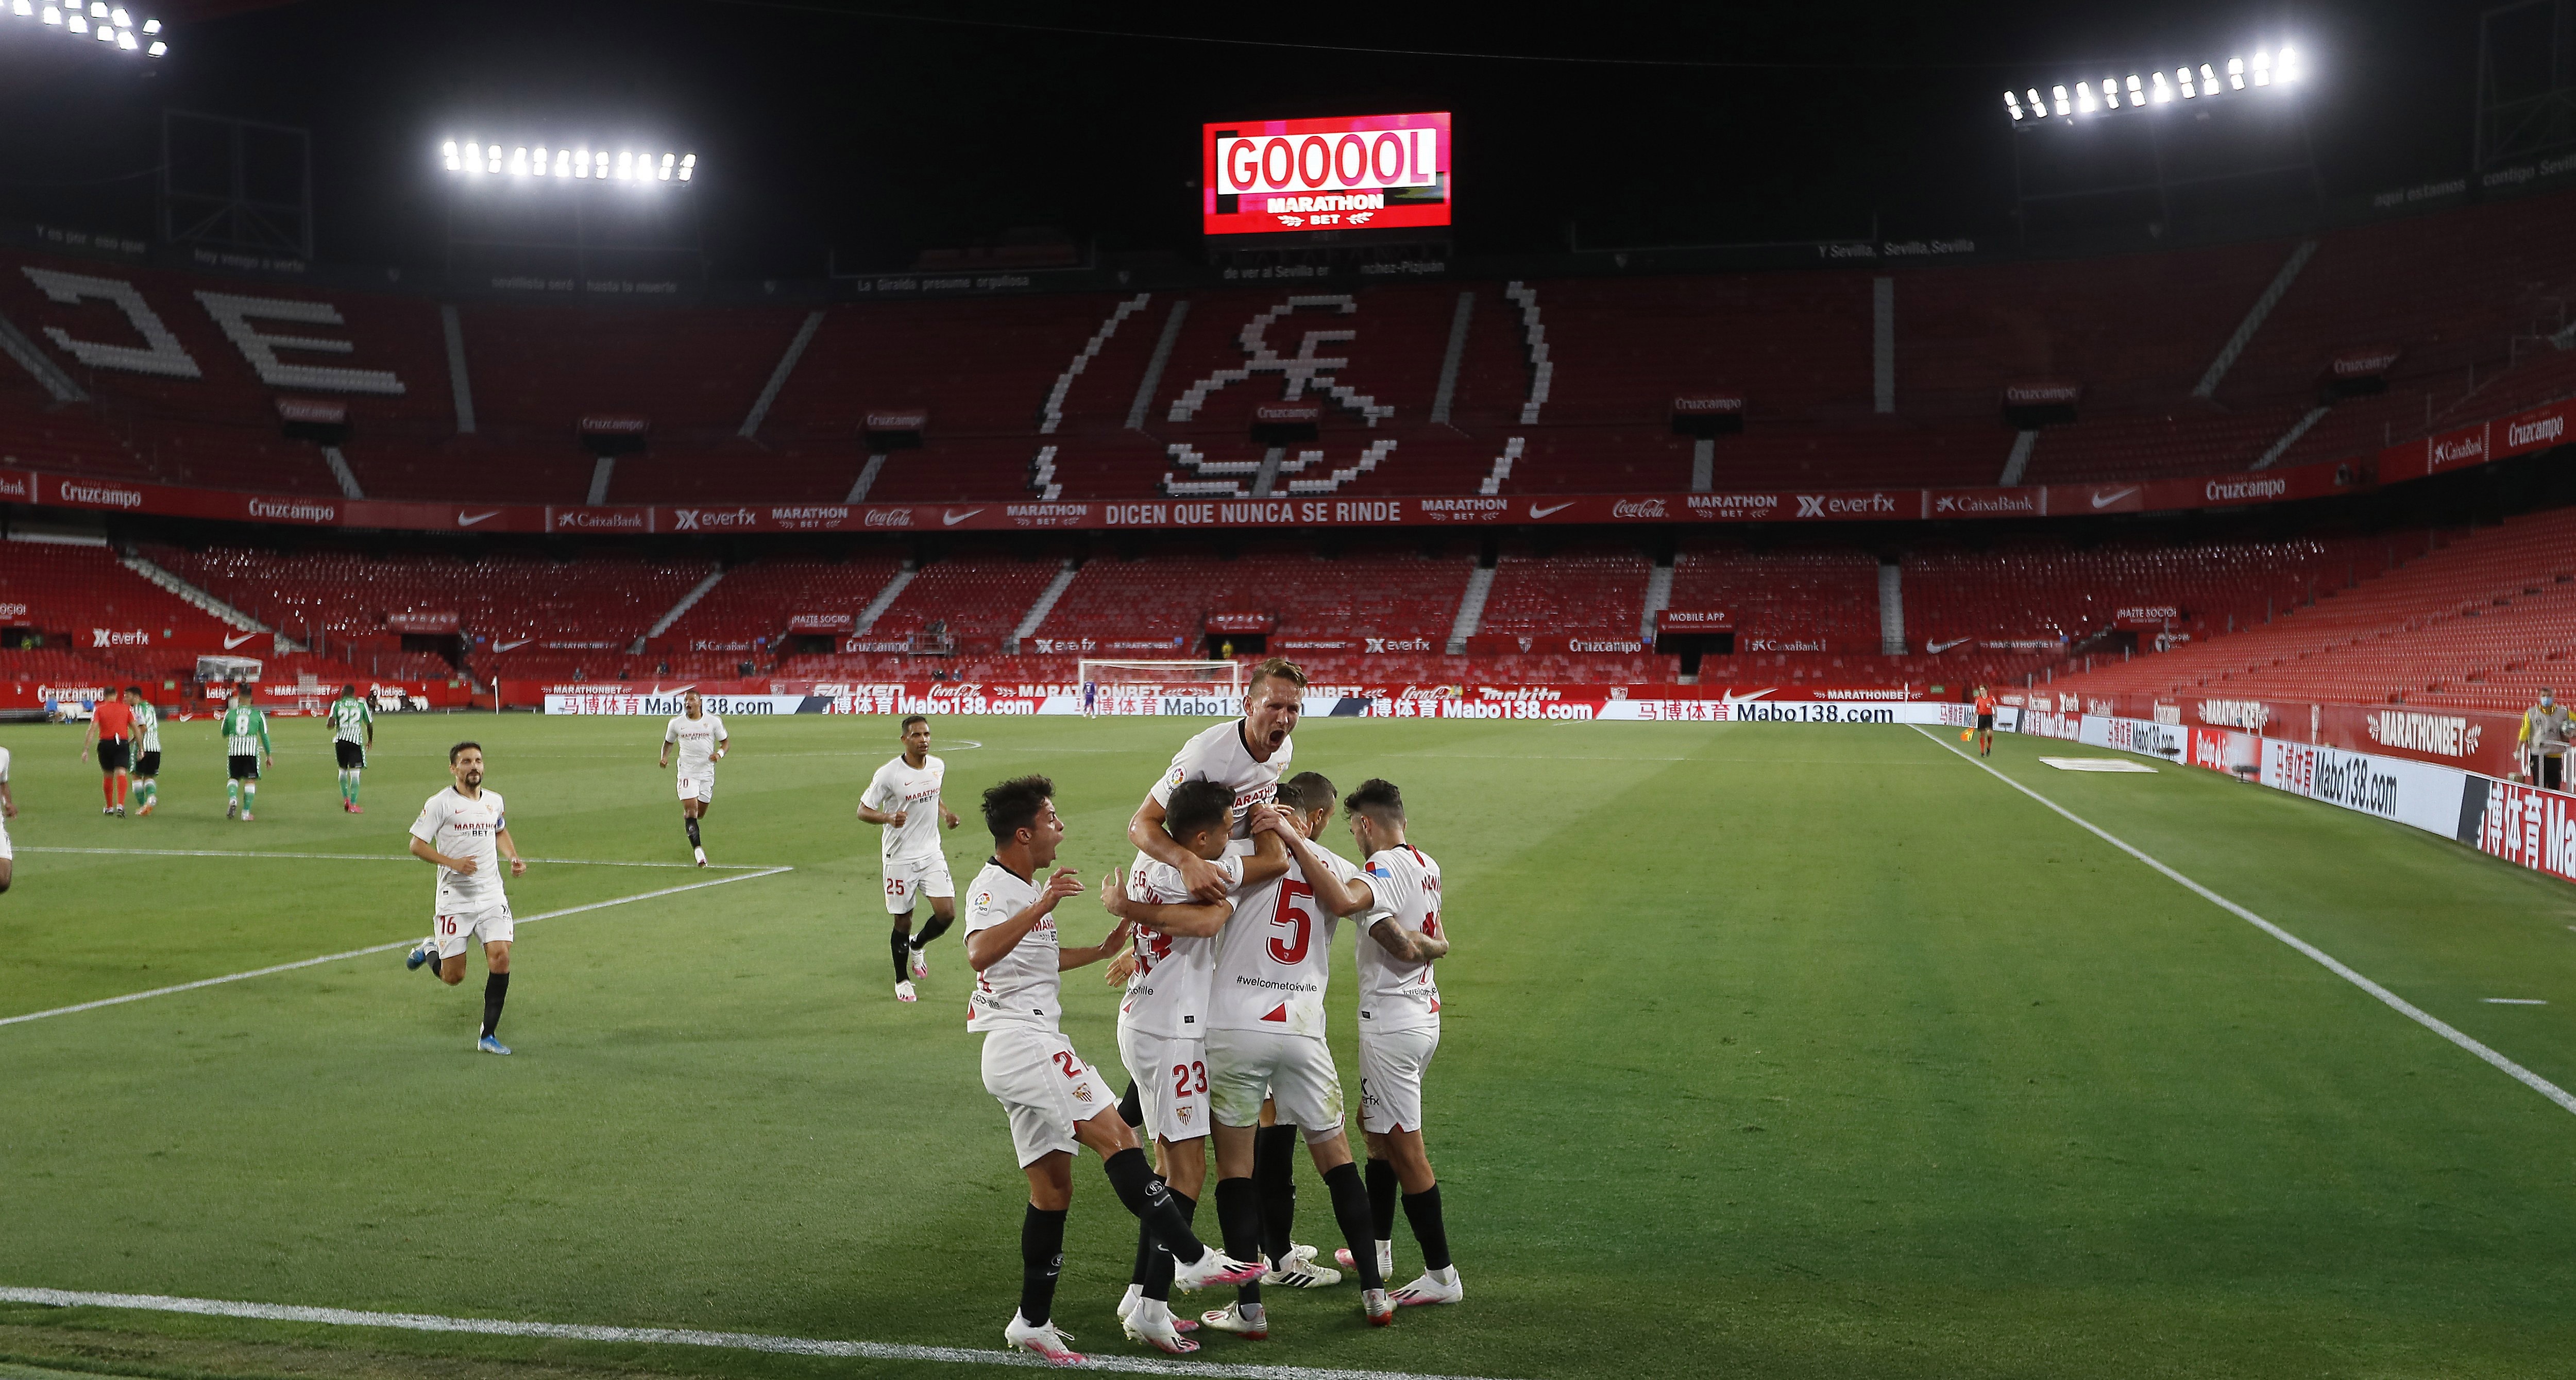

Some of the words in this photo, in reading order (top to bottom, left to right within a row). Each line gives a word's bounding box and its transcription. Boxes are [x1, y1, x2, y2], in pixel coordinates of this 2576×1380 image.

[1227, 132, 1428, 191] GOOOOL
[2407, 179, 2466, 201] estamos
[2483, 166, 2535, 186] contigo
[1267, 194, 1384, 213] MARATHON
[1310, 214, 1340, 225] BET
[1818, 245, 1827, 258] Y
[1275, 264, 1314, 278] Sevilla
[858, 280, 871, 292] La
[877, 277, 917, 291] Giralda
[922, 277, 971, 292] presume
[2007, 387, 2076, 400] Cruzcampo
[1675, 396, 1741, 411] Cruzcampo
[1257, 406, 1318, 420] Cruzcampo
[582, 417, 643, 431] Cruzcampo
[2509, 415, 2564, 448] Cruzcampo
[60, 481, 141, 507] Cruzcampo
[2206, 478, 2285, 500] Cruzcampo
[248, 498, 334, 522] Cruzcampo
[1421, 500, 1507, 511] MARATHON
[1688, 496, 1777, 508] MARATHON
[1829, 494, 1894, 514] everfx
[1958, 494, 2033, 513] CaixaBank
[702, 508, 756, 526] everfx
[772, 507, 848, 519] MARATHON
[1006, 505, 1087, 517] MARATHON
[1106, 505, 1166, 524] DICEN
[1174, 504, 1214, 524] QUE
[1221, 503, 1294, 523] NUNCA
[1301, 503, 1328, 522] SE
[1336, 502, 1401, 522] RINDE
[578, 514, 642, 527] CaixaBank
[822, 615, 850, 624] SOCIO!
[1669, 612, 1704, 621] MOBILE
[1707, 612, 1725, 621] APP
[112, 628, 149, 645] everfx
[1387, 638, 1430, 651] everfx
[708, 641, 750, 651] CaixaBank
[846, 639, 909, 653] Cruzcampo
[1570, 638, 1642, 654] Cruzcampo
[553, 685, 621, 694] MARATHONBET
[813, 684, 906, 697] FALKEN
[1827, 689, 1910, 701] MARATHONBET
[564, 693, 639, 715] 马博体育
[898, 696, 1030, 715] Mabo138.com
[1443, 700, 1592, 719] Mabo138.com
[1638, 702, 1731, 722] 马博体育
[1738, 703, 1893, 723] Mabo138.com
[235, 714, 249, 736] 8
[337, 708, 361, 728] 22
[2040, 710, 2078, 742] Mabo138.com
[2381, 710, 2466, 757] MARATHONBET
[679, 778, 689, 790] 20
[2314, 751, 2398, 816] Mabo138.com
[886, 878, 905, 896] 25
[440, 915, 457, 935] 16
[1265, 877, 1313, 965] 5
[1173, 1061, 1209, 1099] 23
